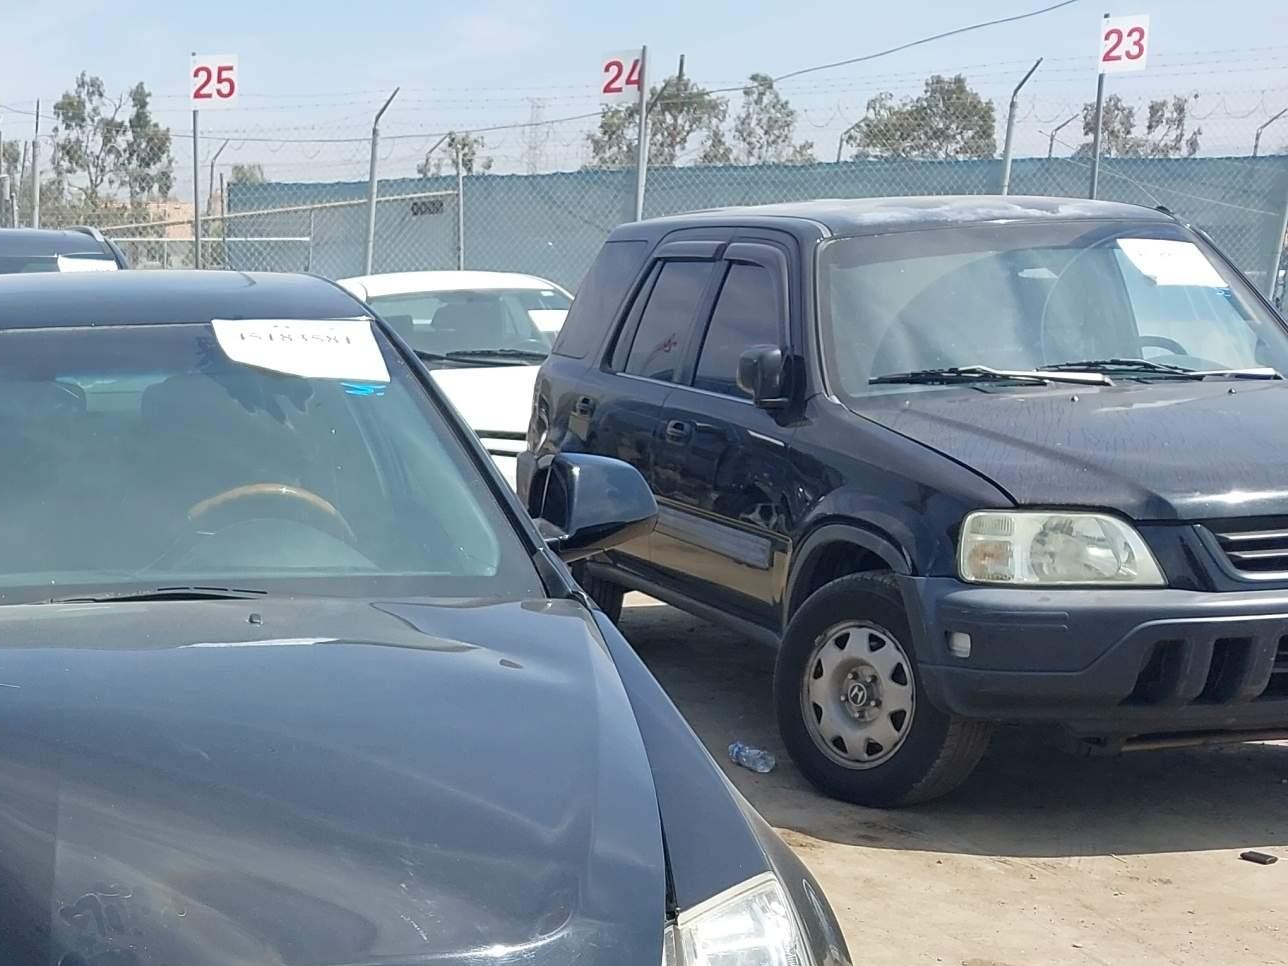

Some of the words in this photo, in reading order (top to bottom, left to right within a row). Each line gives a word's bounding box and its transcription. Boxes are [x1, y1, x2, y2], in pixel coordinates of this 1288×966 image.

[1103, 27, 1145, 62] 23
[193, 65, 235, 99] 25
[602, 59, 641, 94] 24
